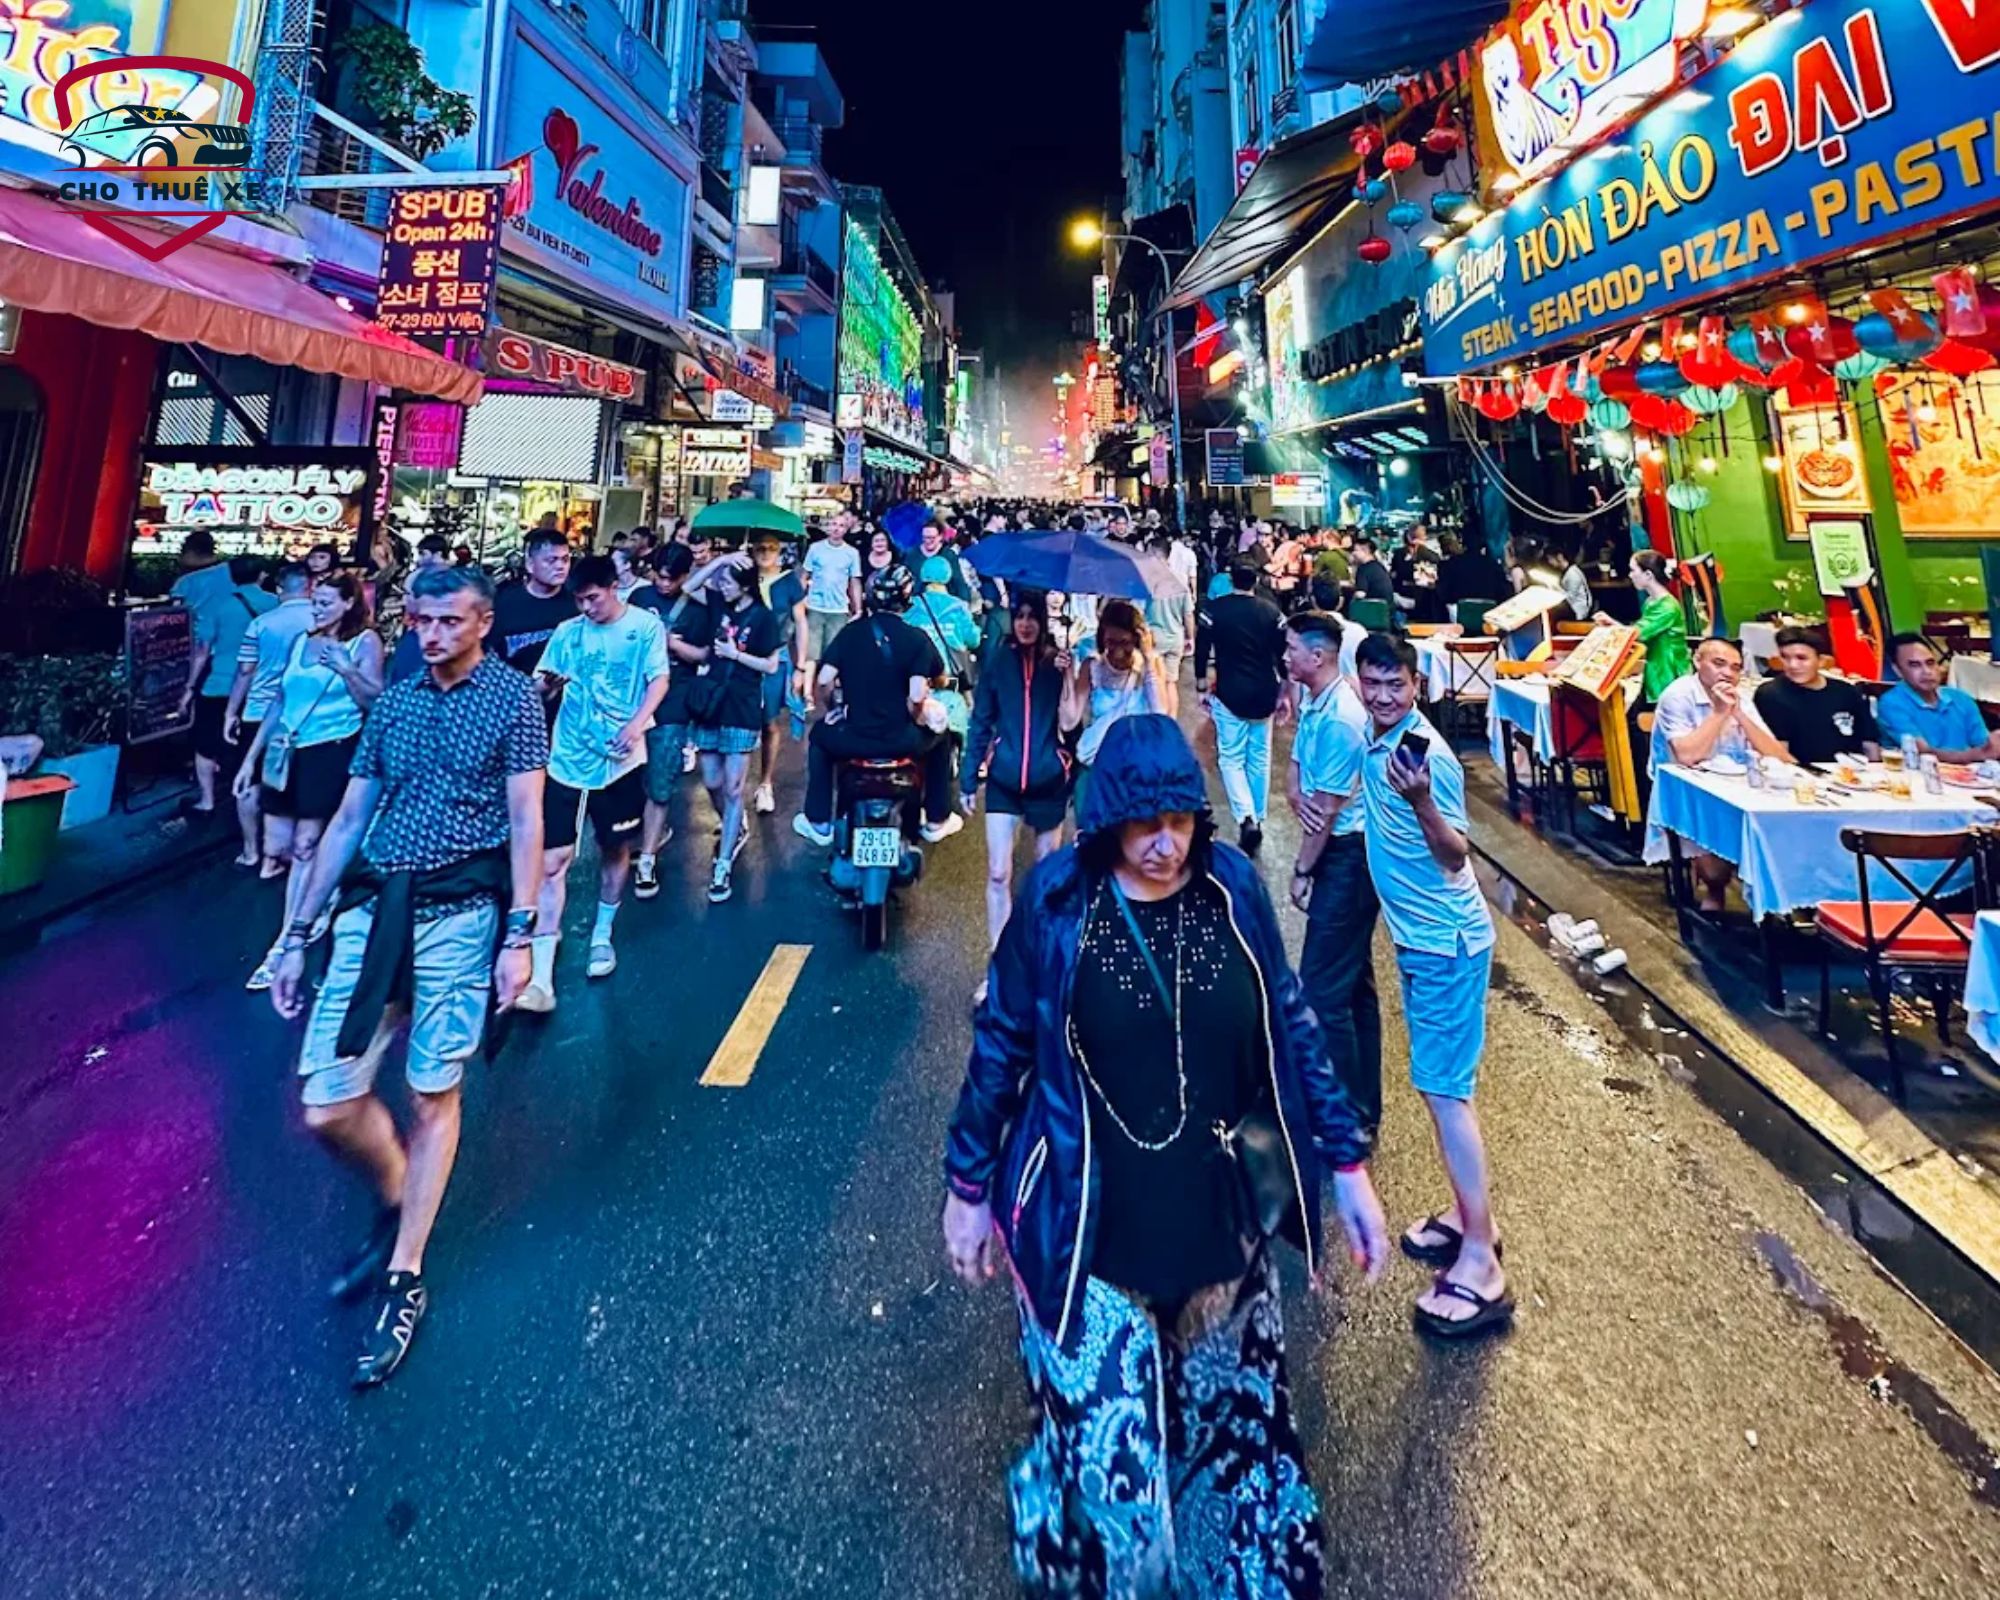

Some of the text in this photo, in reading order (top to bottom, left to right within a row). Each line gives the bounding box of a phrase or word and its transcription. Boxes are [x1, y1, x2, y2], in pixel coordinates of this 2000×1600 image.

[0, 5, 184, 133] iger
[1514, 196, 1595, 284] HÒN
[1597, 134, 1716, 243] ĐẢO
[1727, 8, 1893, 177] ĐẠI
[398, 189, 488, 220] SPUB
[545, 118, 662, 257] Valentine
[394, 221, 488, 246] Open 24h
[411, 248, 461, 277] 풍선
[382, 280, 482, 308] 소녀 점프
[1461, 314, 1517, 363] STEAK
[497, 336, 635, 399] S PUB
[160, 493, 344, 526] TATTOO
